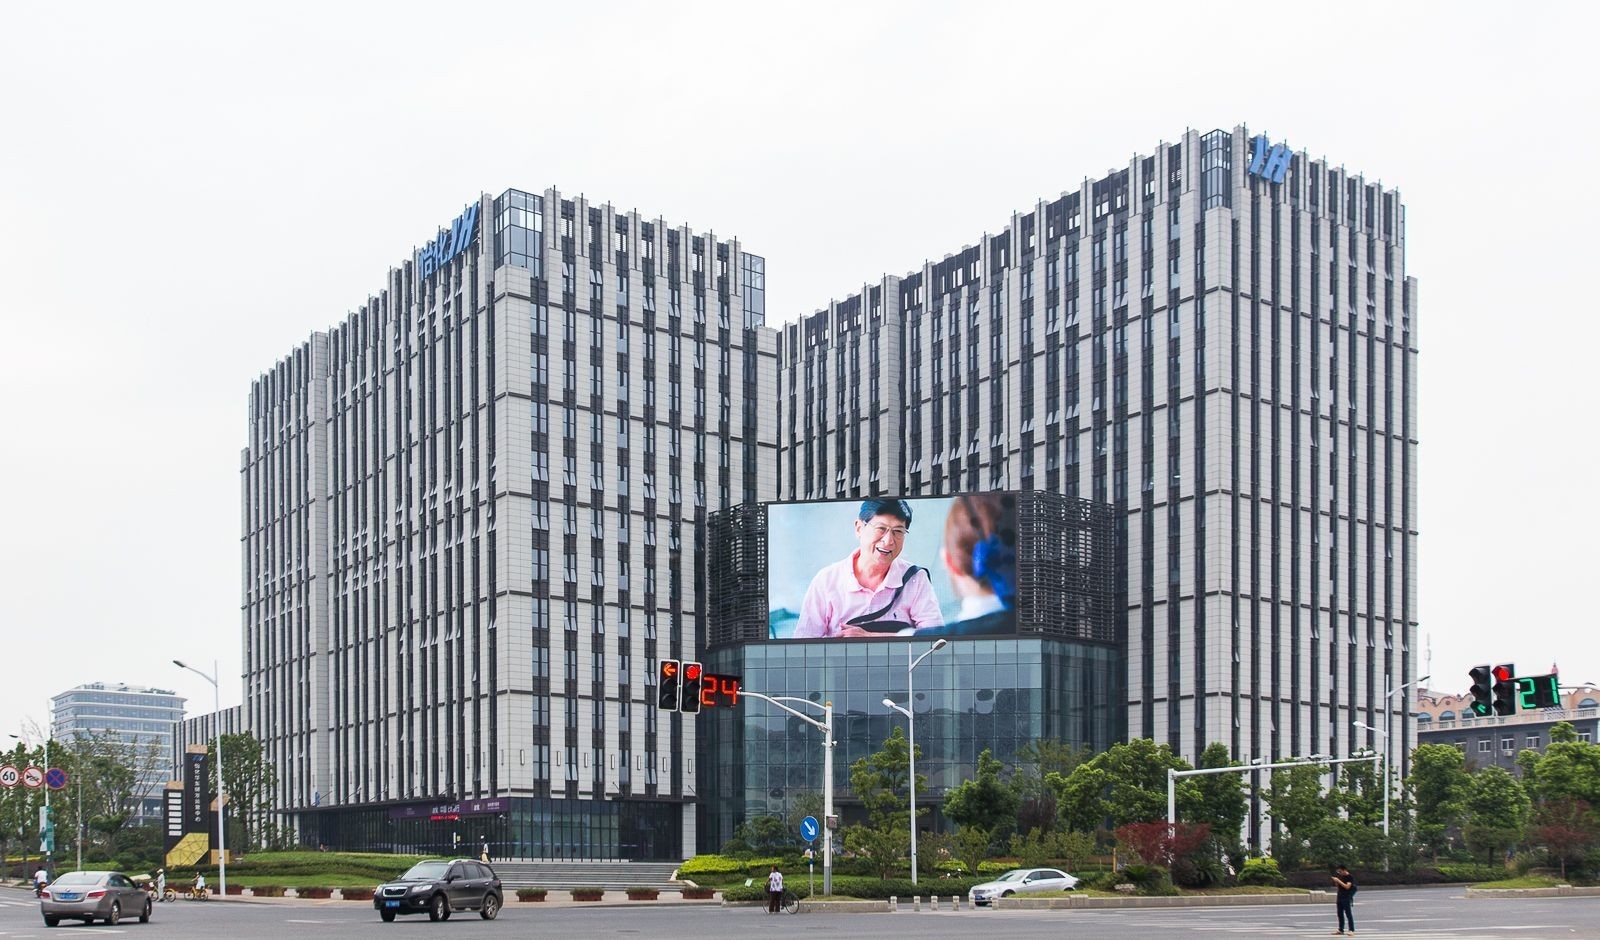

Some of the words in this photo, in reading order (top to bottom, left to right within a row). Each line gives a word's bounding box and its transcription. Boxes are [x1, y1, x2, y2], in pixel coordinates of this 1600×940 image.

[701, 676, 739, 707] 24
[1519, 677, 1559, 709] 21
[2, 770, 16, 781] 60
